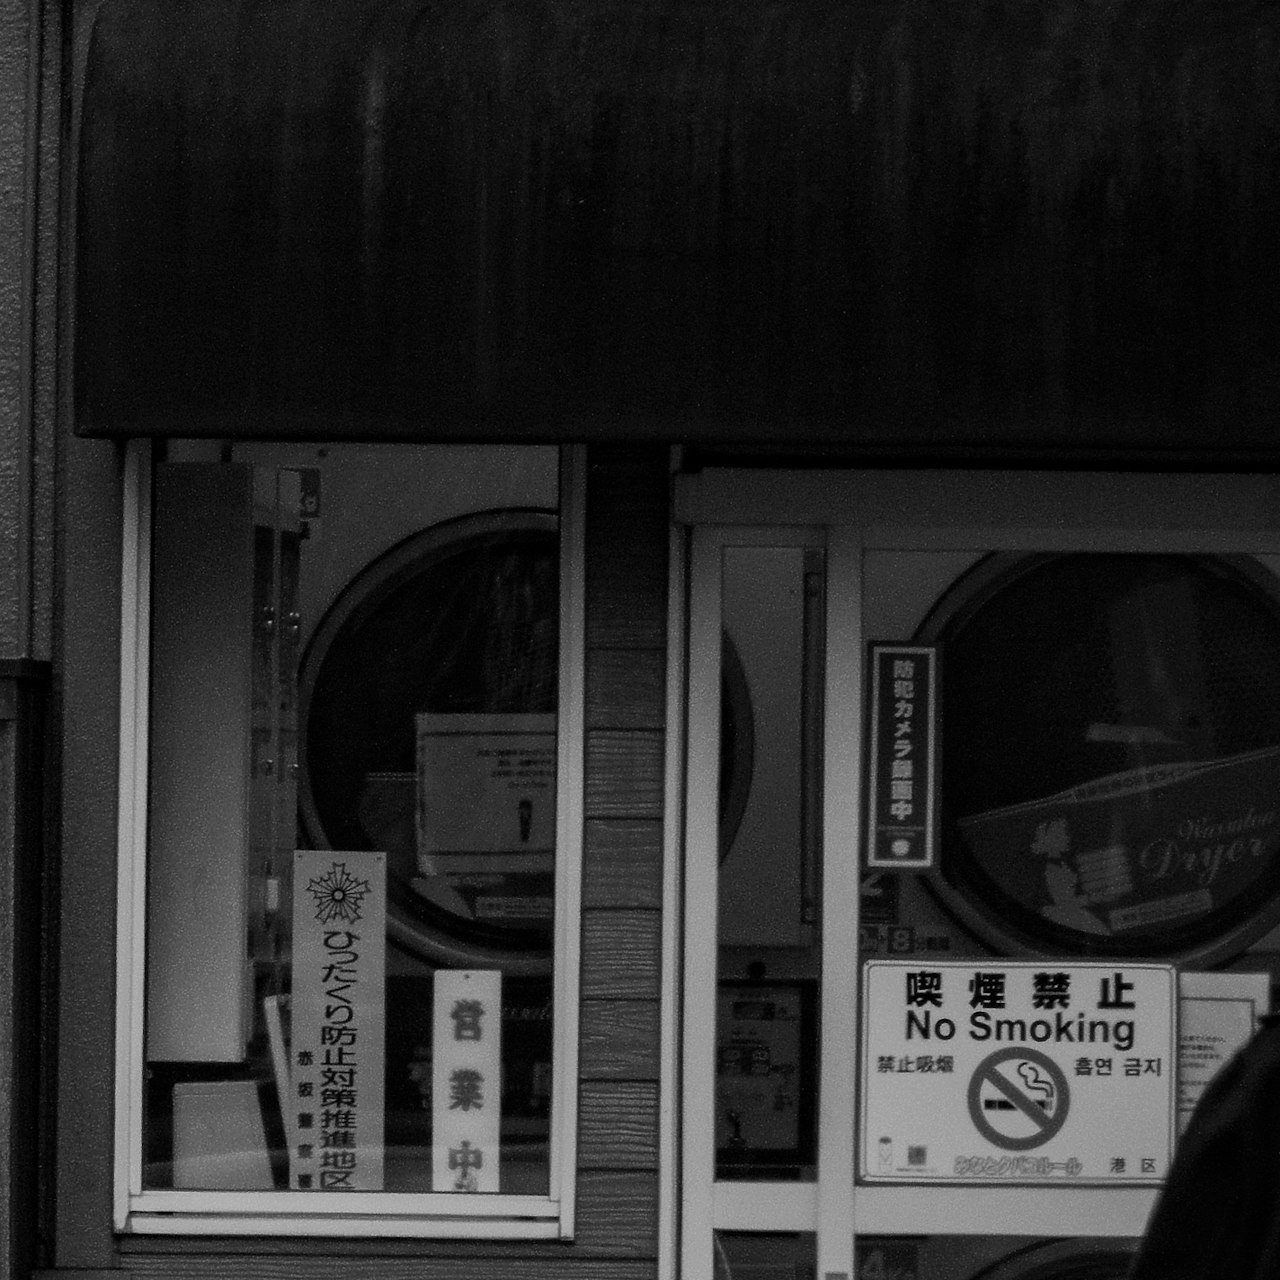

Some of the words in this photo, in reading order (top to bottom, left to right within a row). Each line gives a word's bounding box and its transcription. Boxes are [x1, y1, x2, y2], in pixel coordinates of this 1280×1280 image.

[905, 971, 1137, 1010] 喫煙禁止
[906, 1010, 956, 1041] No
[969, 1011, 1135, 1051] Smoking
[320, 930, 360, 1190] ひったくり防止対策推進地区
[1074, 1057, 1112, 1076] 흡연
[1123, 1057, 1161, 1077] 금지
[448, 999, 486, 1179] 営業中
[1111, 1157, 1157, 1174] 港区
